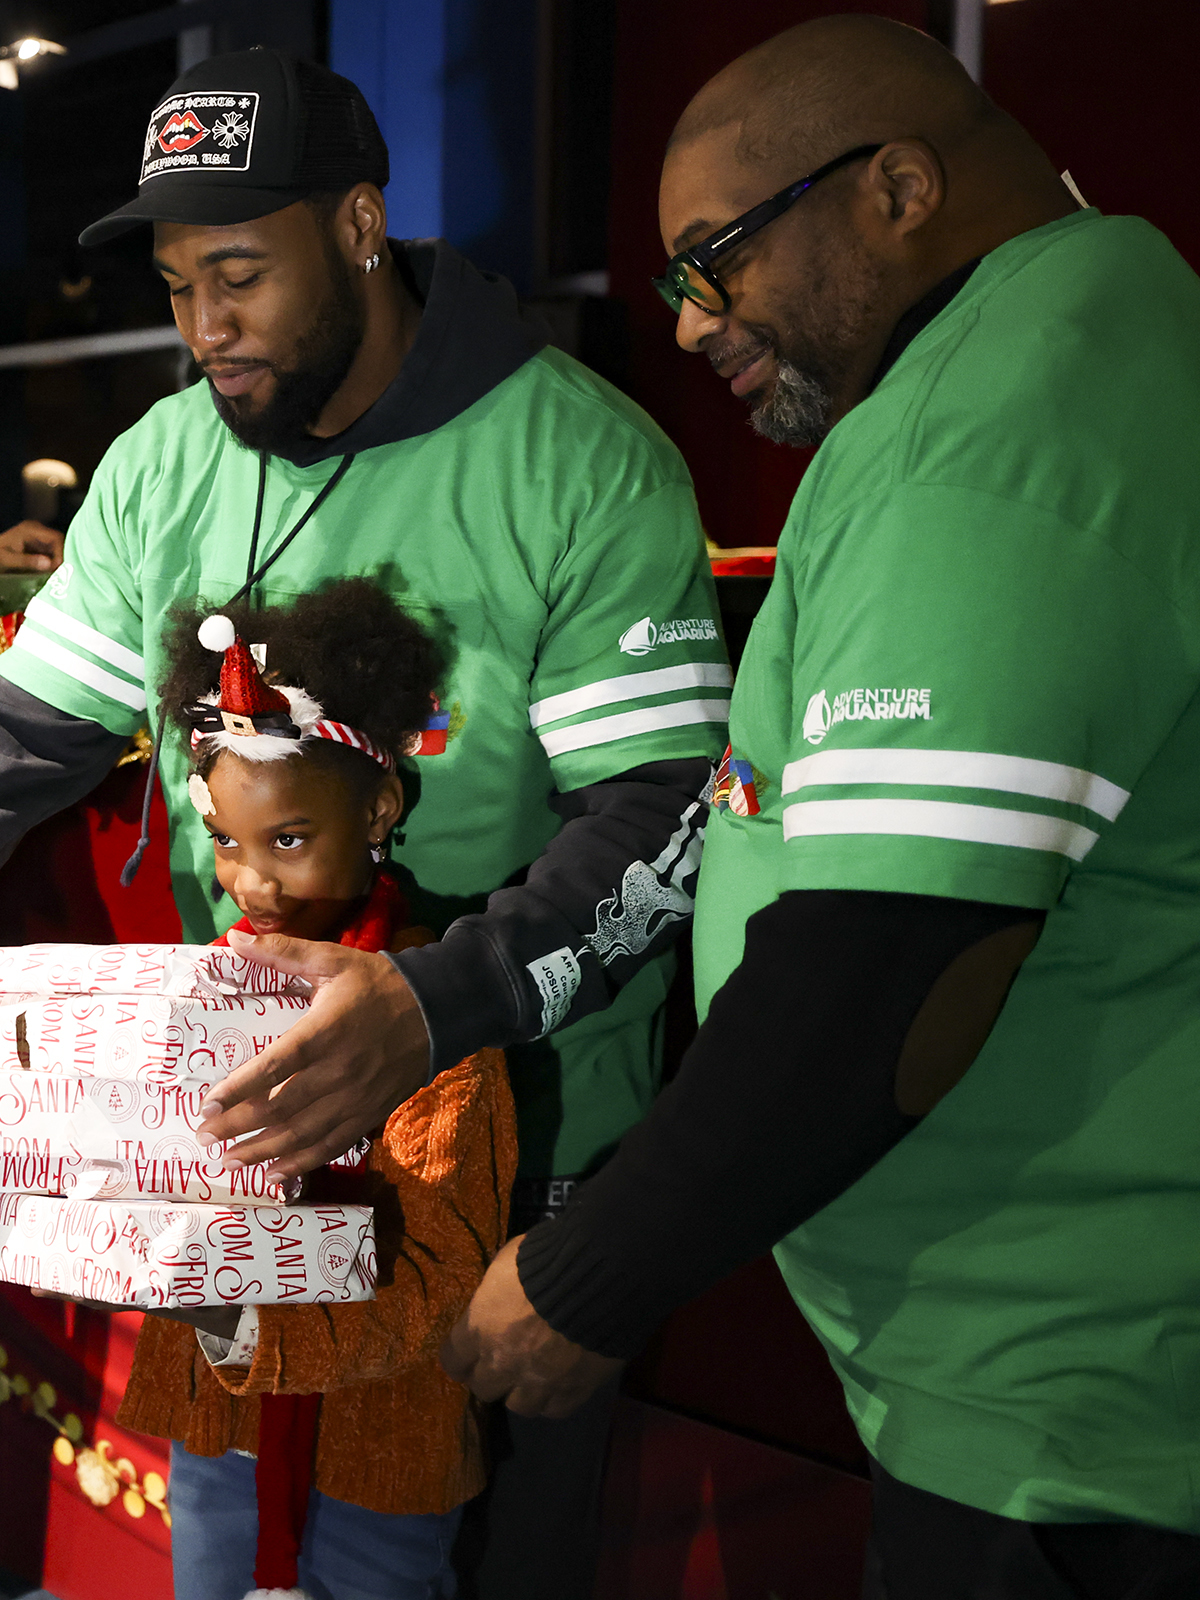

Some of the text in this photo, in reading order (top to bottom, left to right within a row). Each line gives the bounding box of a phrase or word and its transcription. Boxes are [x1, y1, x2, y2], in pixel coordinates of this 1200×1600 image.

[184, 96, 236, 109] HEARTS
[201, 152, 231, 165] USA
[657, 628, 719, 645] AQUARIUM
[659, 618, 715, 632] ADVENTURE
[831, 701, 931, 726] AQUARIUM
[832, 688, 931, 710] ADVENTURE
[561, 955, 575, 973] ART
[542, 965, 561, 1001] JOSUE
[142, 1083, 204, 1133] FRO
[2, 1156, 79, 1195] FROM
[135, 1160, 226, 1201] SANTA
[230, 1162, 280, 1200] ROM
[206, 1207, 254, 1262] ROM
[254, 1207, 308, 1299] SANTA
[157, 1244, 208, 1306] FRO
